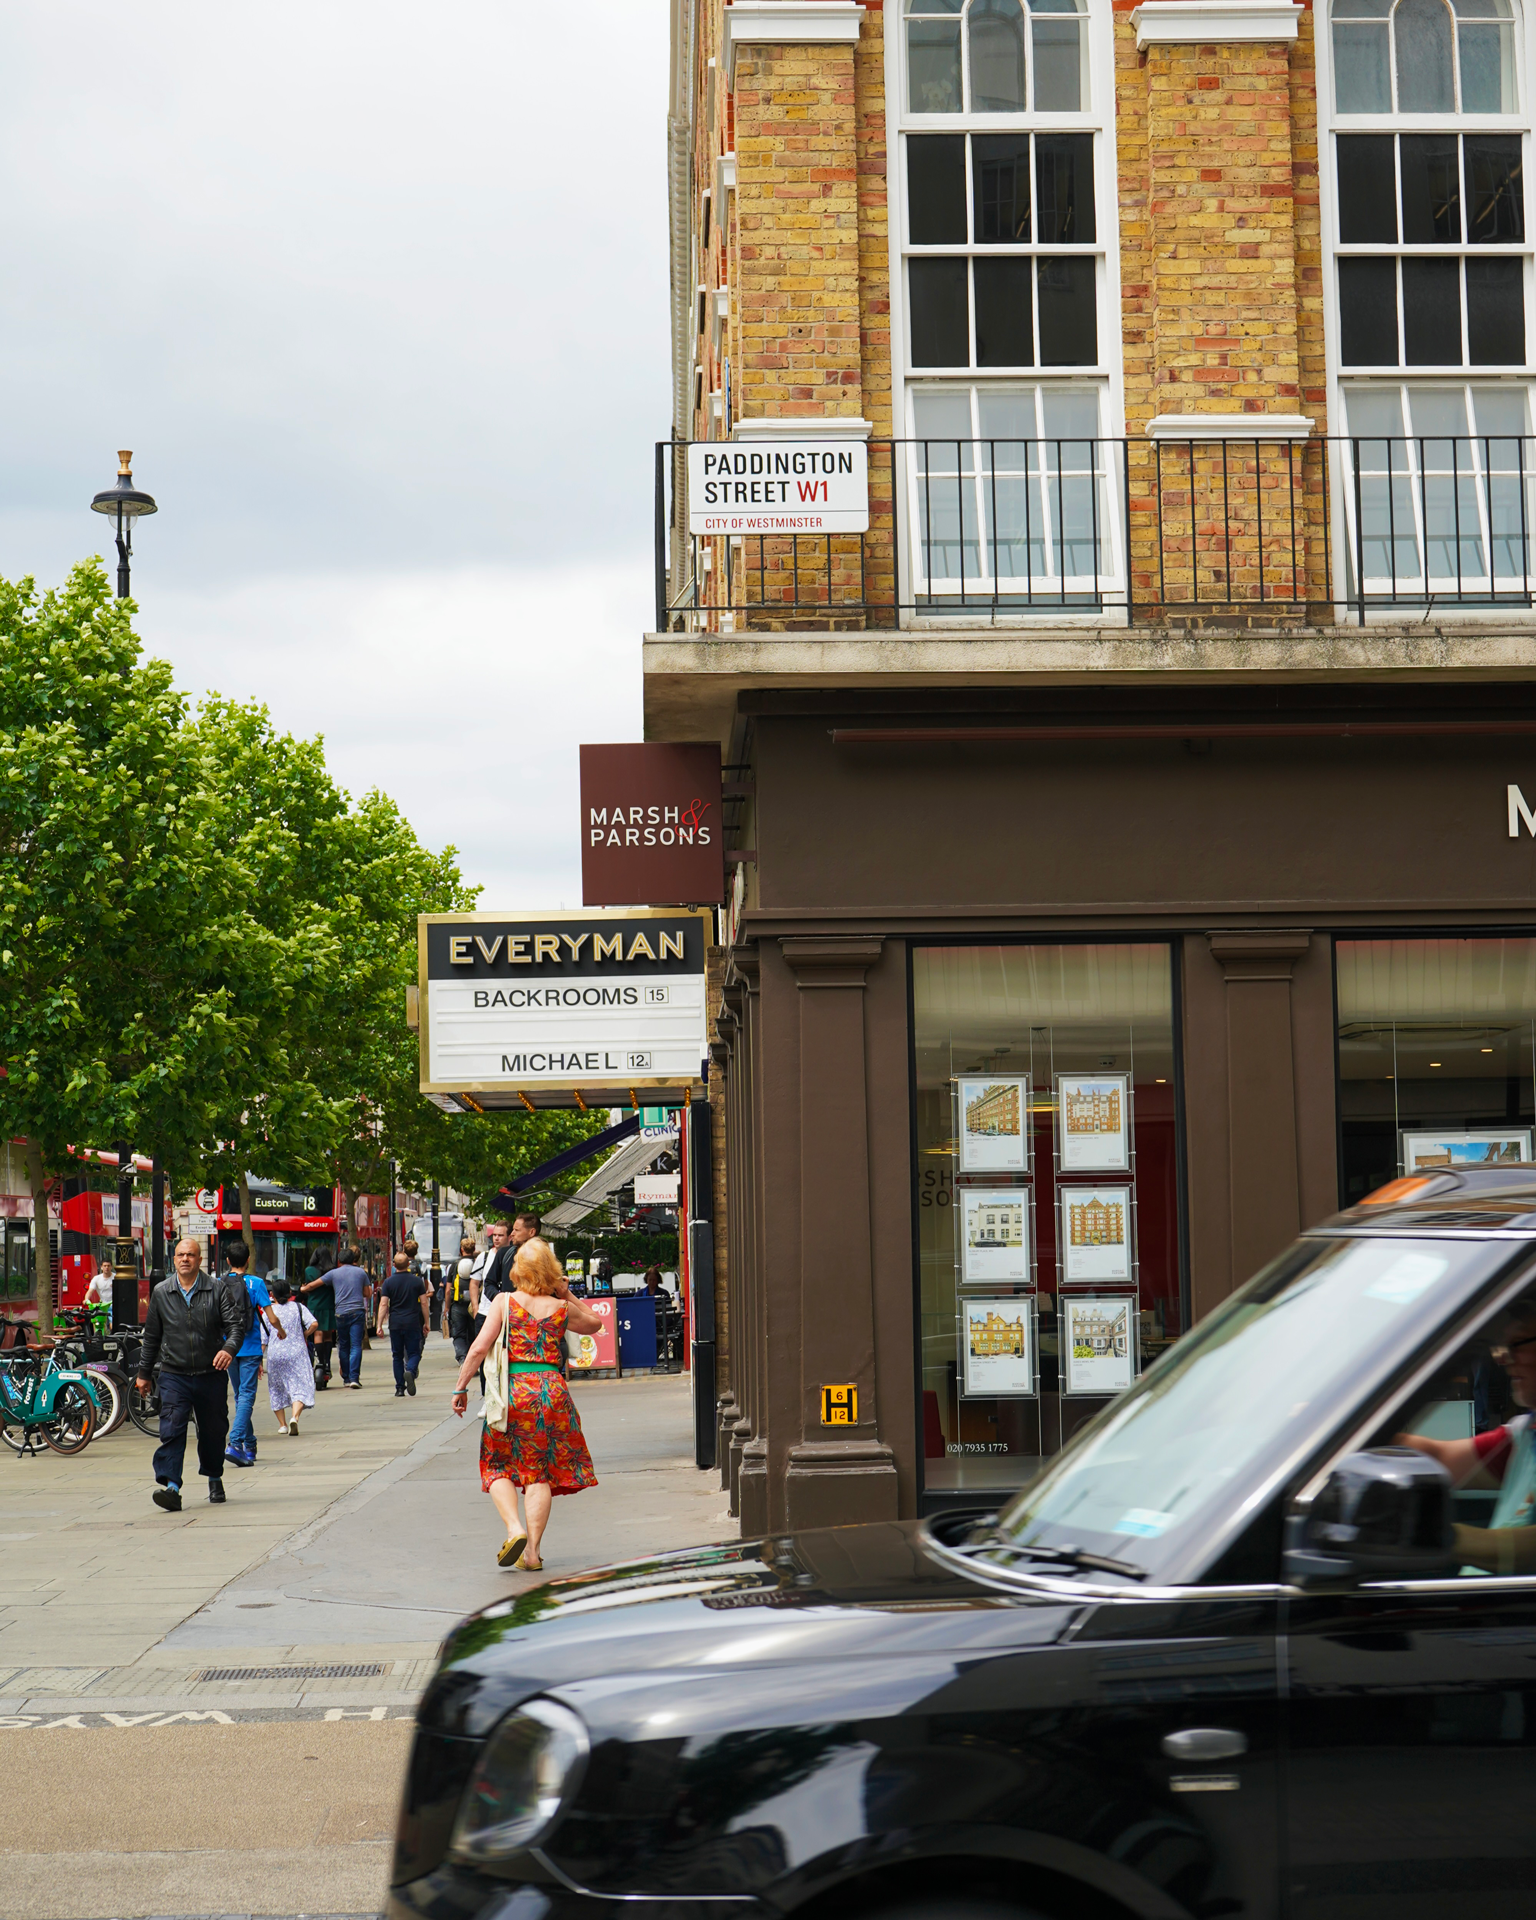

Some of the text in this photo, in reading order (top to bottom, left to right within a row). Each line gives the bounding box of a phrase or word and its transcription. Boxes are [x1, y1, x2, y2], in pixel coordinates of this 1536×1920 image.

[704, 452, 852, 475] PADDINGTON
[704, 480, 829, 504] STREET W1
[705, 517, 823, 529] CITY OF WESTMINSTER
[590, 806, 679, 826] MARSH
[590, 826, 711, 847] PARSONS
[449, 930, 685, 964] EVERYMAN
[474, 987, 665, 1008] BACKROOMS 15
[501, 1052, 618, 1072] MICHAEL
[255, 1197, 289, 1208] Euston
[303, 1196, 316, 1211] 18
[23, 1377, 35, 1405] forest
[836, 1391, 843, 1401] 6
[834, 1410, 846, 1420] 12
[947, 1443, 1009, 1453] 020 7935 1775
